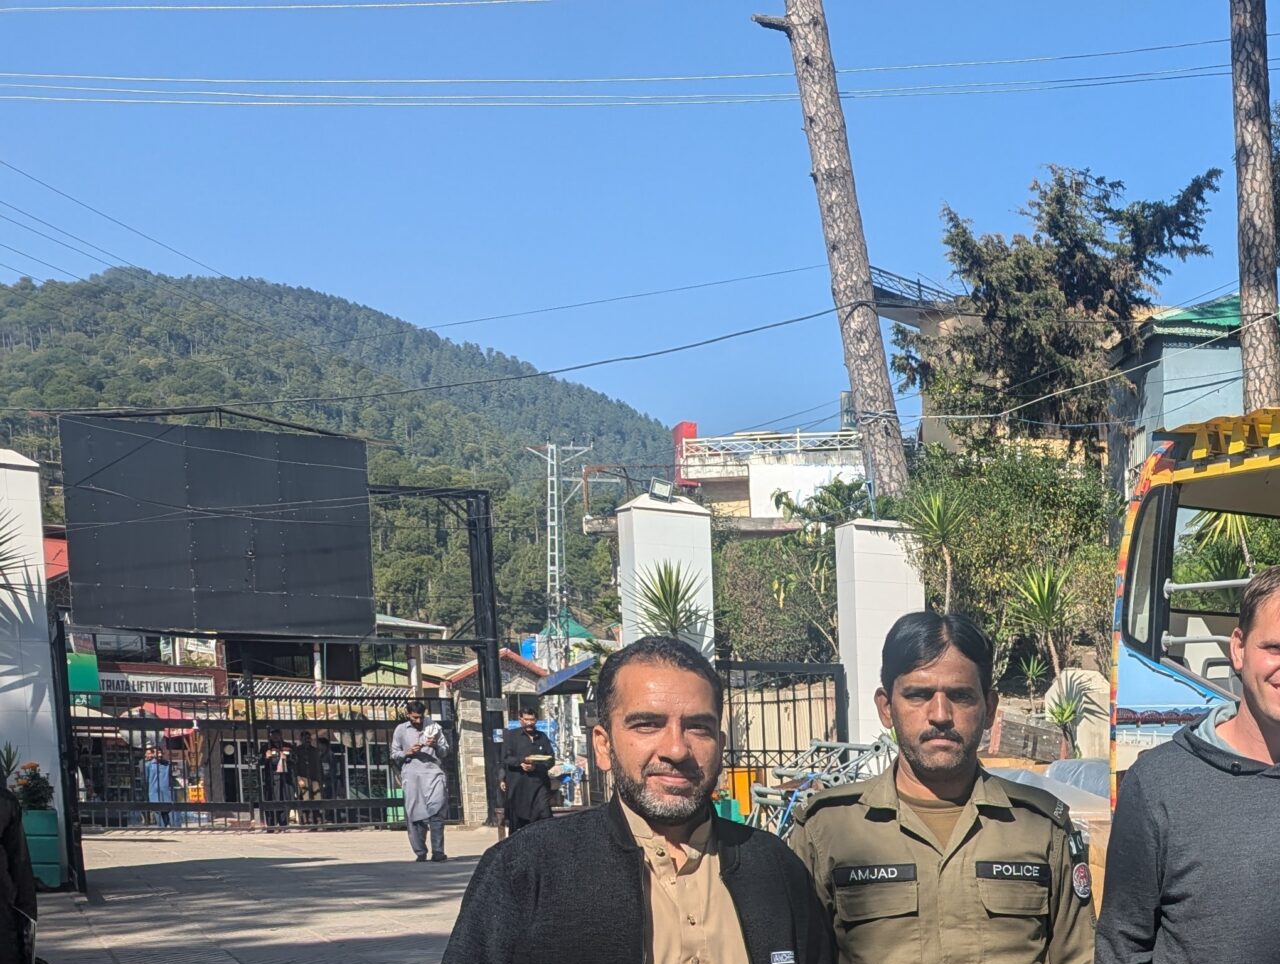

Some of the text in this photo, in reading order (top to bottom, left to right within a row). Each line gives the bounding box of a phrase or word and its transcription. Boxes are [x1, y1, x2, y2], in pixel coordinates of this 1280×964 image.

[99, 679, 131, 691] TRIATA
[173, 682, 209, 694] COTTAGE
[849, 867, 898, 881] AMJAD
[992, 864, 1040, 877] POLICE
